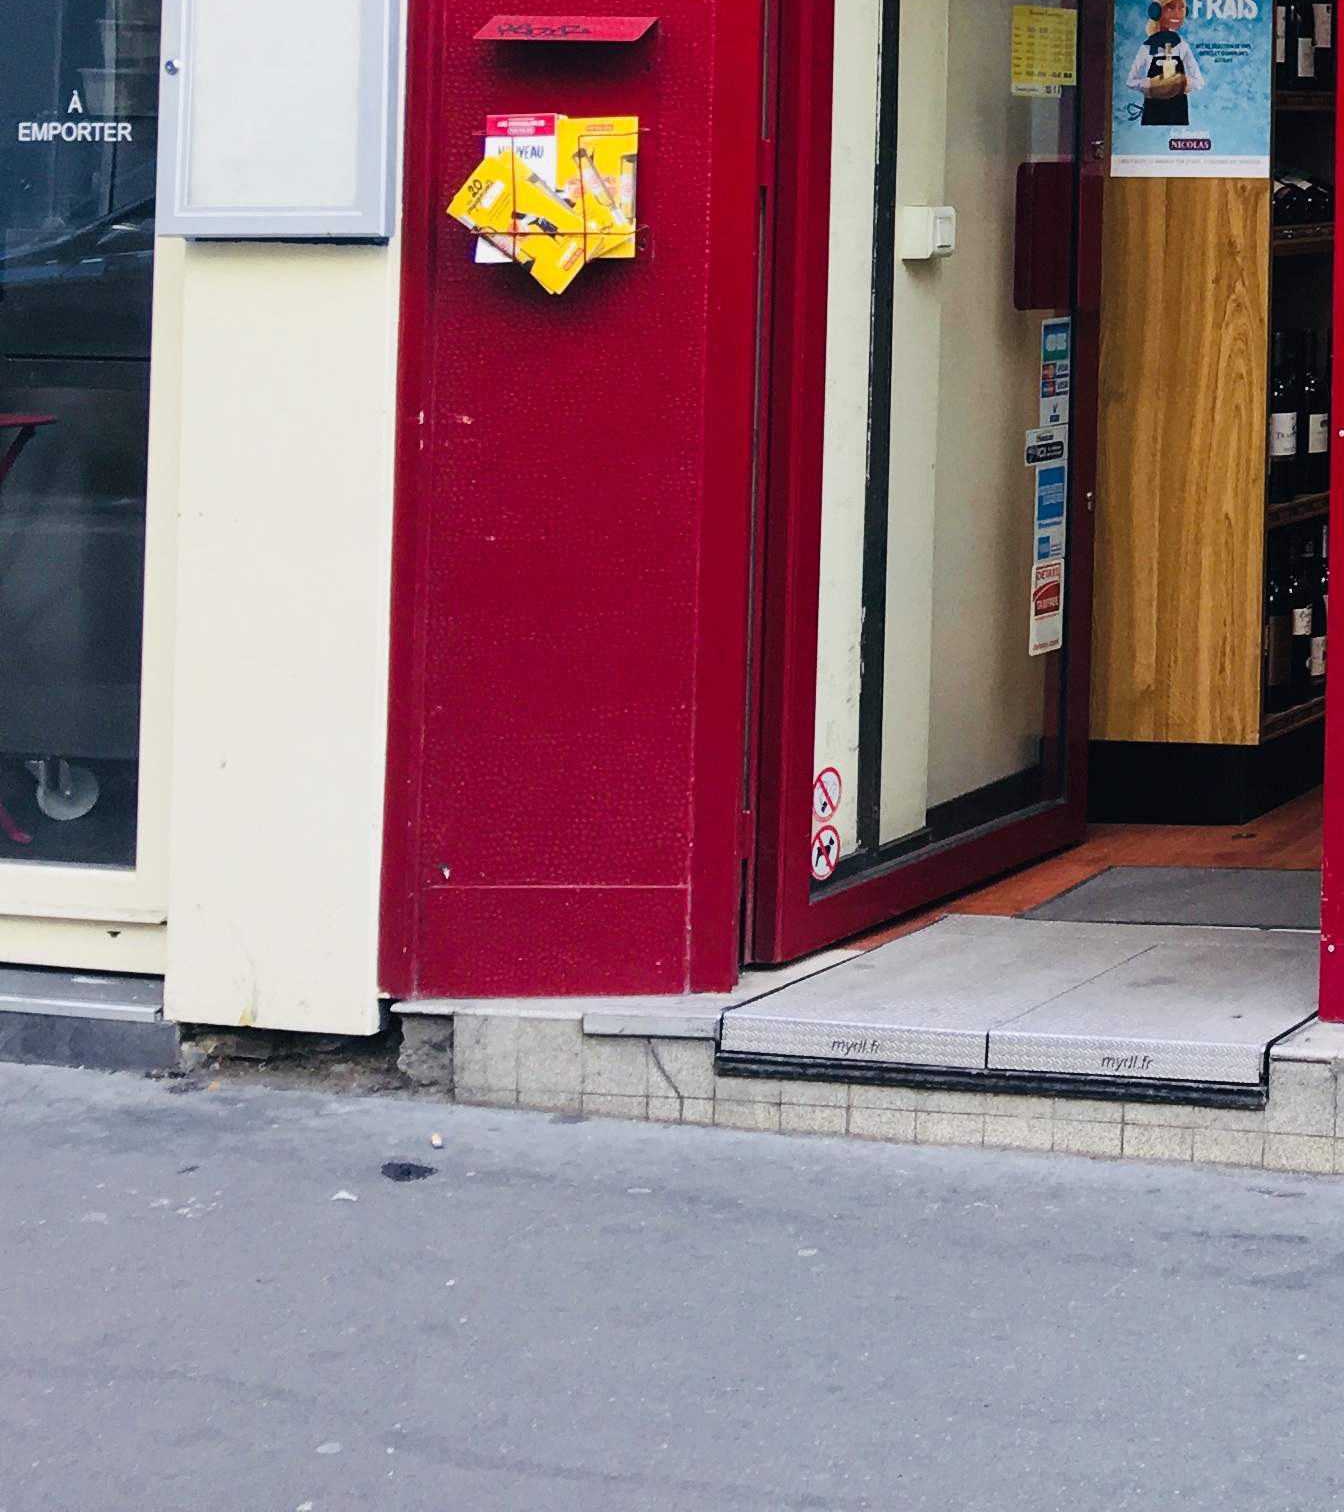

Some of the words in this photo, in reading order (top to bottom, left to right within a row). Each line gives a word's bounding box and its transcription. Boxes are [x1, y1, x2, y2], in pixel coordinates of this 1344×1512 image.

[67, 89, 83, 113] À
[18, 122, 133, 142] EMPORTER
[1171, 140, 1209, 149] NICOLAS
[1101, 1055, 1154, 1070] mydl.fr
